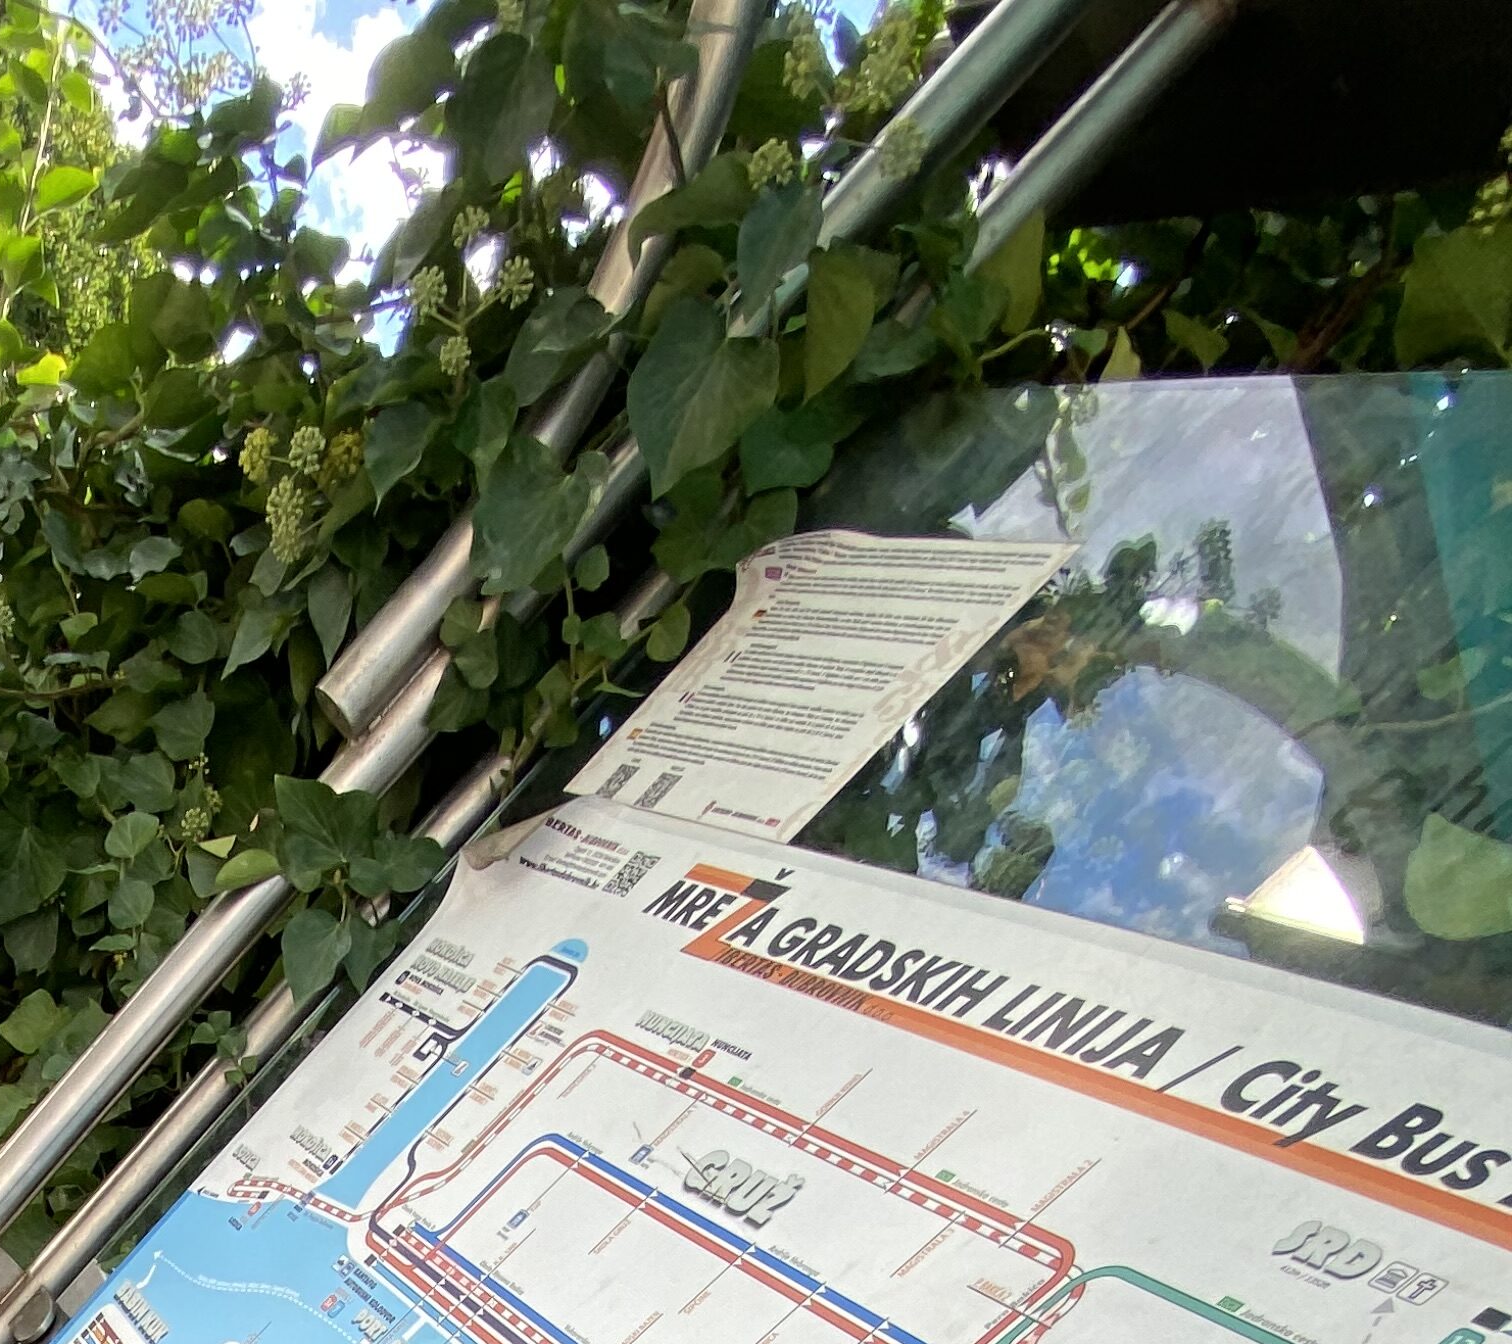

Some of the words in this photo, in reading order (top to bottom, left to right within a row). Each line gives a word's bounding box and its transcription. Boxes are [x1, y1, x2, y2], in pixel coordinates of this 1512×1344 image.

[641, 863, 795, 962] MREŽA
[768, 912, 1004, 1022] GRADSKIH
[981, 981, 1186, 1082] LINIJA
[1220, 1058, 1368, 1149] City
[1347, 1101, 1512, 1194] Bus
[681, 1145, 807, 1231] GRUŽ
[1029, 1166, 1086, 1213] MAGISTRALA
[896, 1234, 948, 1279] MAGISTRALA
[351, 1307, 389, 1343] PORT
